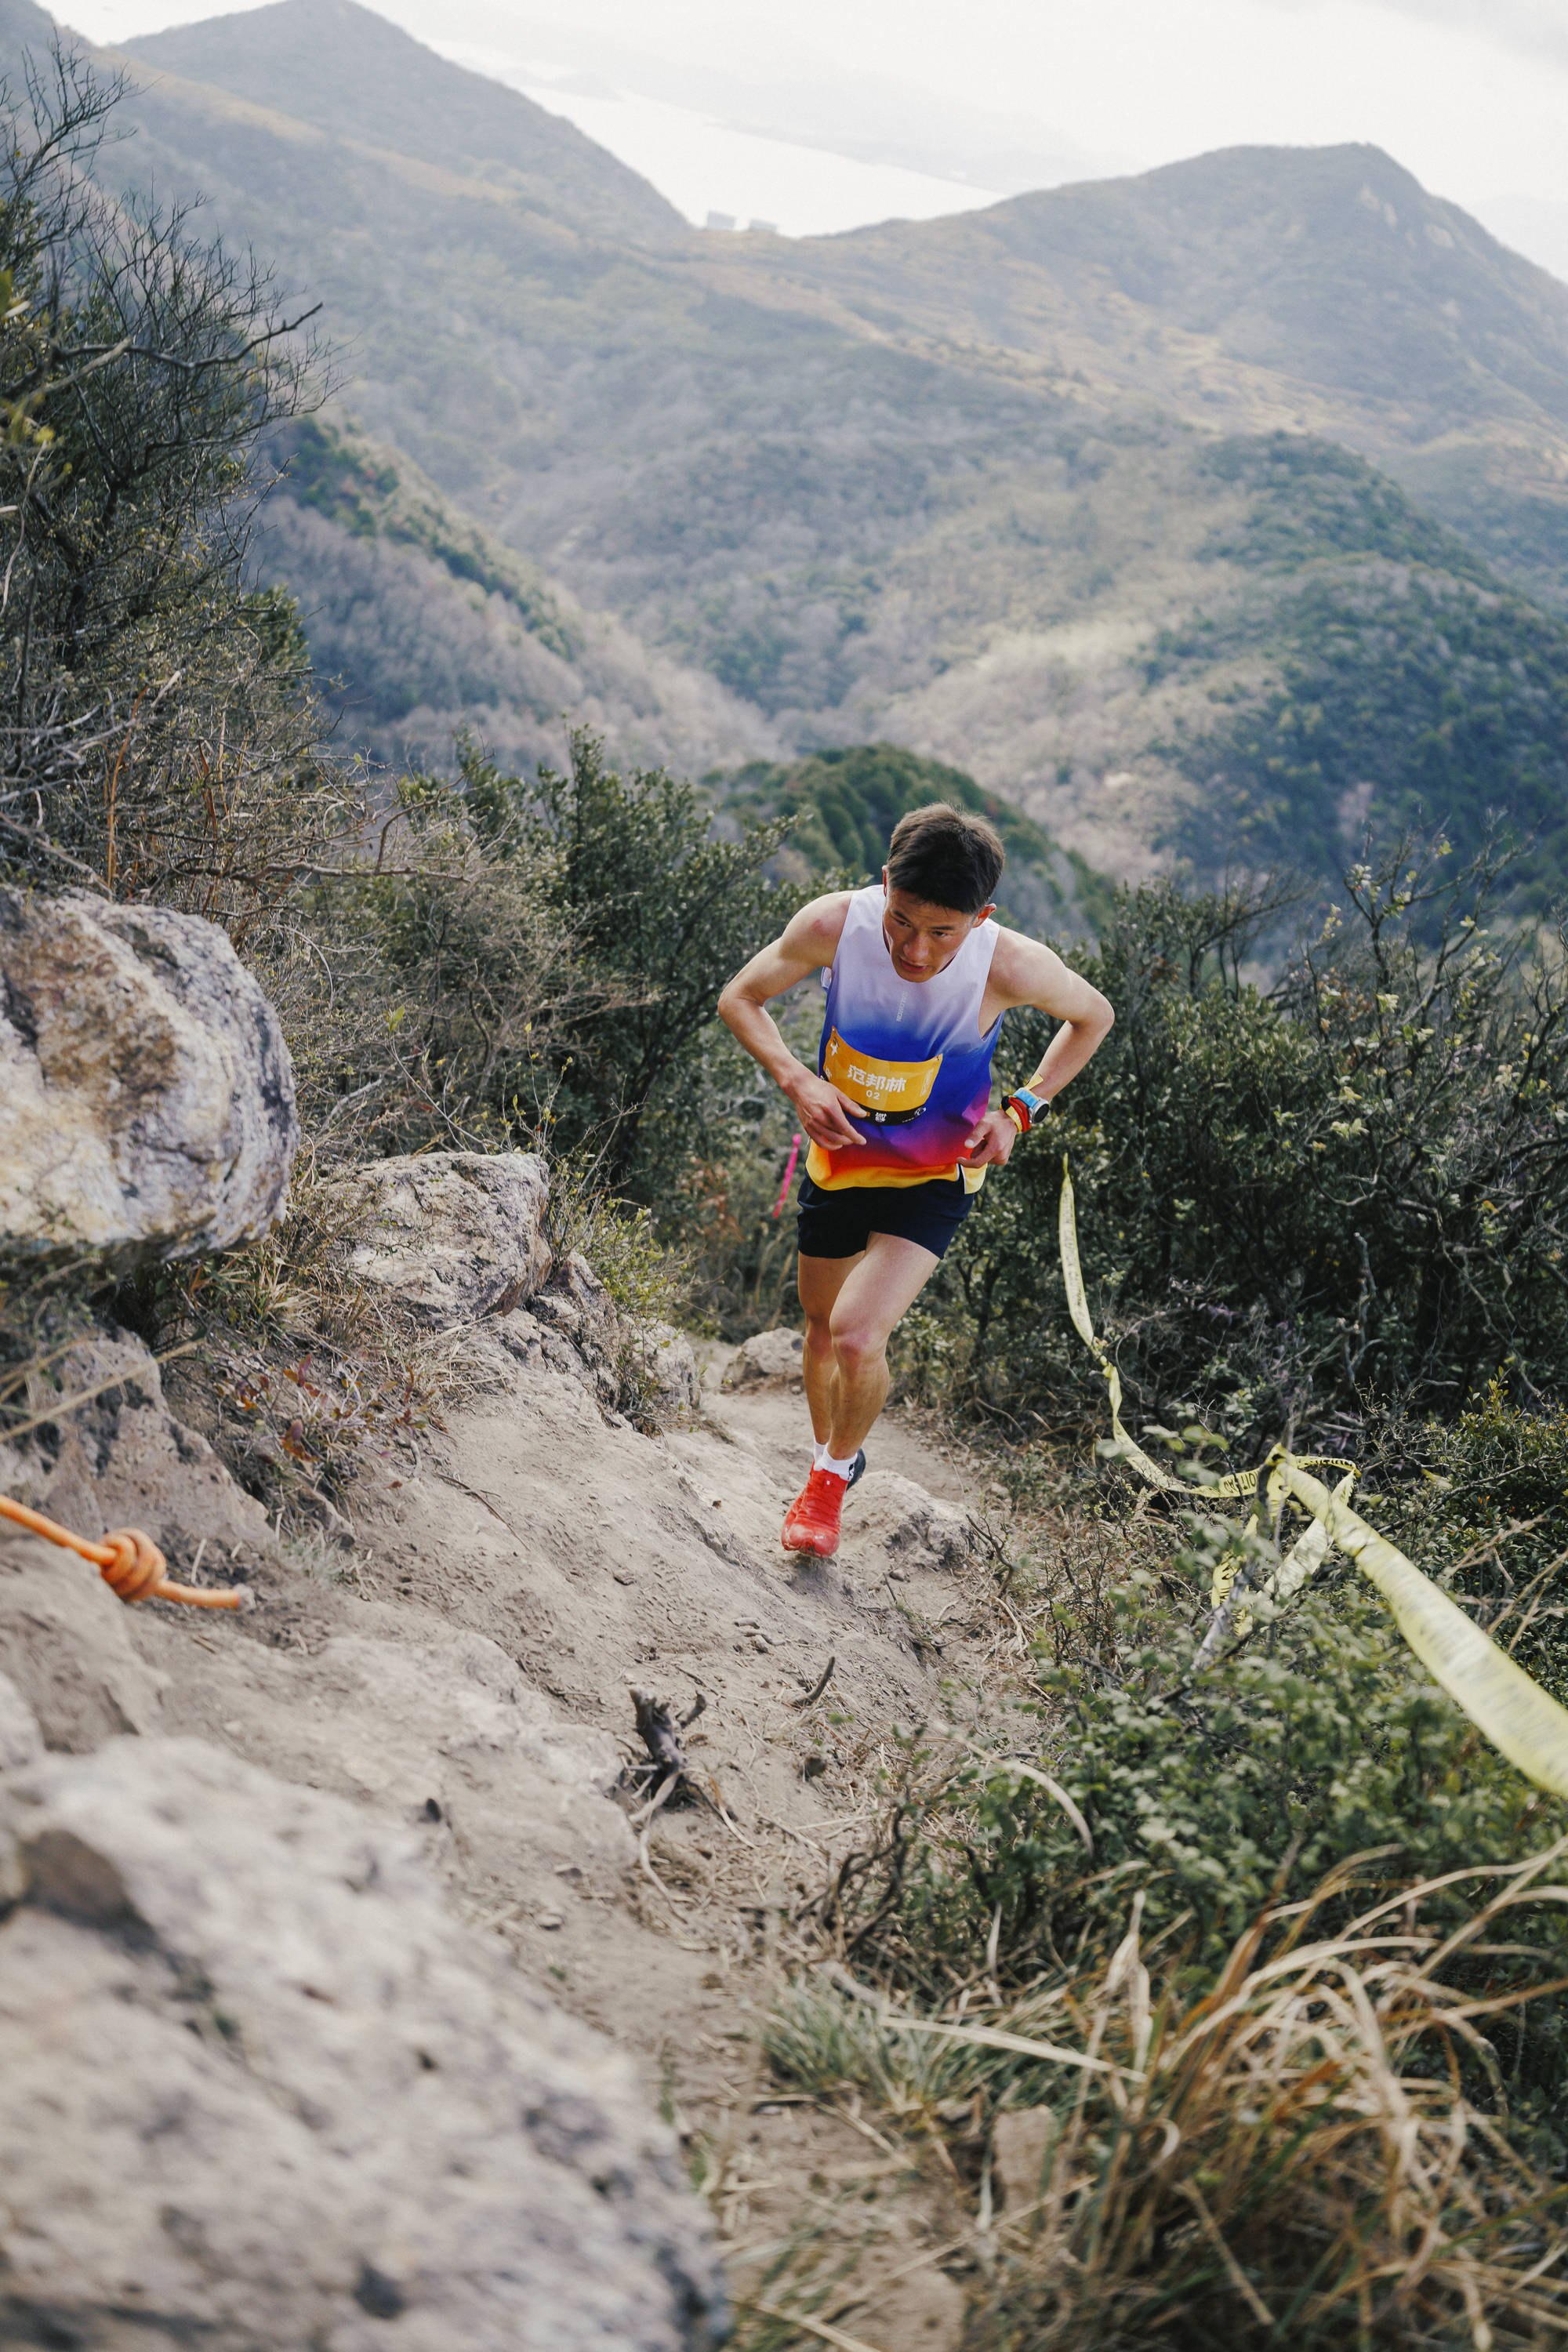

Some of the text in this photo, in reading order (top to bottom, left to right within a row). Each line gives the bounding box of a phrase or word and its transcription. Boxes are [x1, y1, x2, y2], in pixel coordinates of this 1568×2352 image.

[848, 1065, 906, 1092] 范邦林
[866, 1090, 880, 1100] 02
